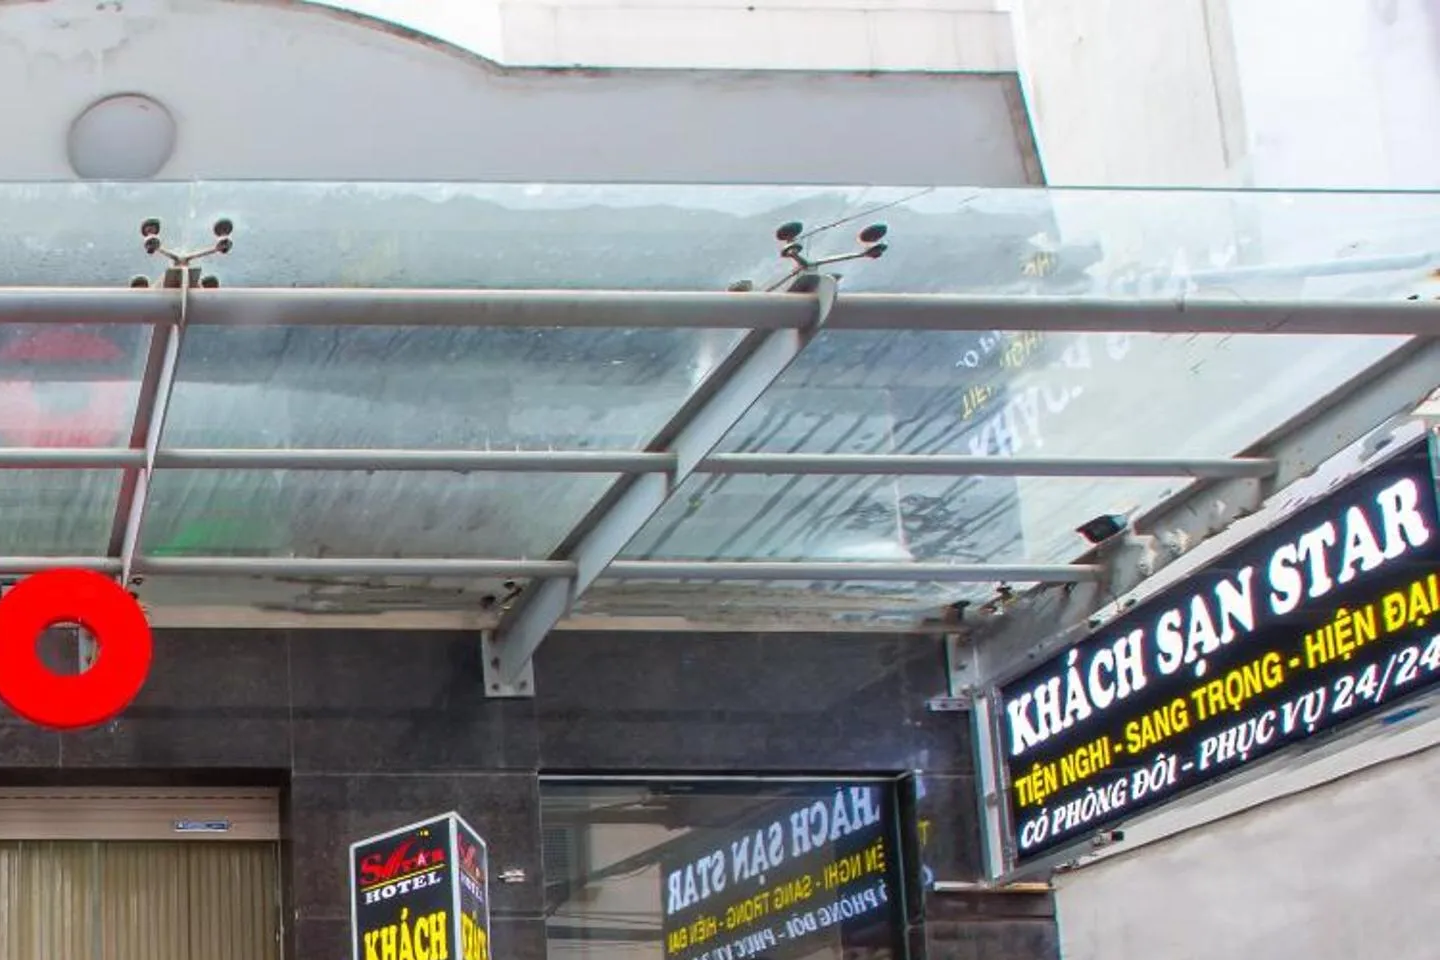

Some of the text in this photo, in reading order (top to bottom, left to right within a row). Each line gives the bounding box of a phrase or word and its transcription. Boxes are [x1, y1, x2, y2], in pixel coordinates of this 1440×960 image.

[1007, 478, 1430, 755] KHÁCH SẠN STAR
[1015, 763, 1059, 806] TIỆN
[1061, 737, 1111, 786] NGHI
[1125, 698, 1190, 754] SANG
[1192, 652, 1285, 720] TRỌNG
[1305, 605, 1377, 669] HIỆN
[1382, 574, 1440, 632] ĐẠI
[1021, 808, 1049, 848] CÓ
[1051, 778, 1128, 835] PHÒNG
[1131, 753, 1177, 801] ĐÔI
[1199, 709, 1277, 771] PHỤC
[1282, 687, 1327, 734] VỤ
[365, 872, 443, 904] HOTEL
